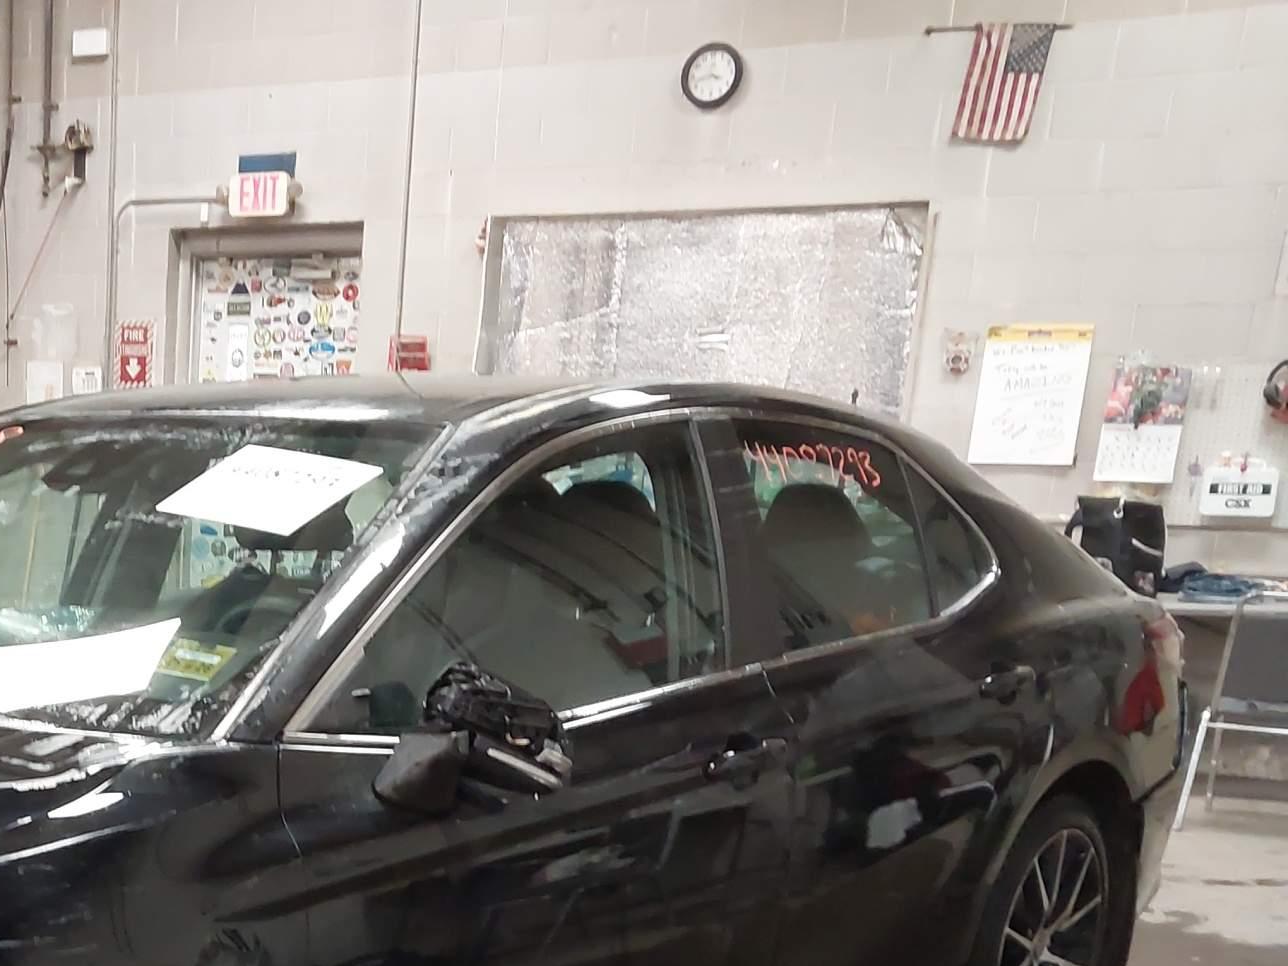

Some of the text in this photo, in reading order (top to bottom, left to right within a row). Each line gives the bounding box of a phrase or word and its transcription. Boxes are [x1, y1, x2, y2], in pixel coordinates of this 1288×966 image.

[240, 174, 280, 212] EXIT
[124, 328, 146, 342] FIRE
[1218, 484, 1264, 495] FIRST AID
